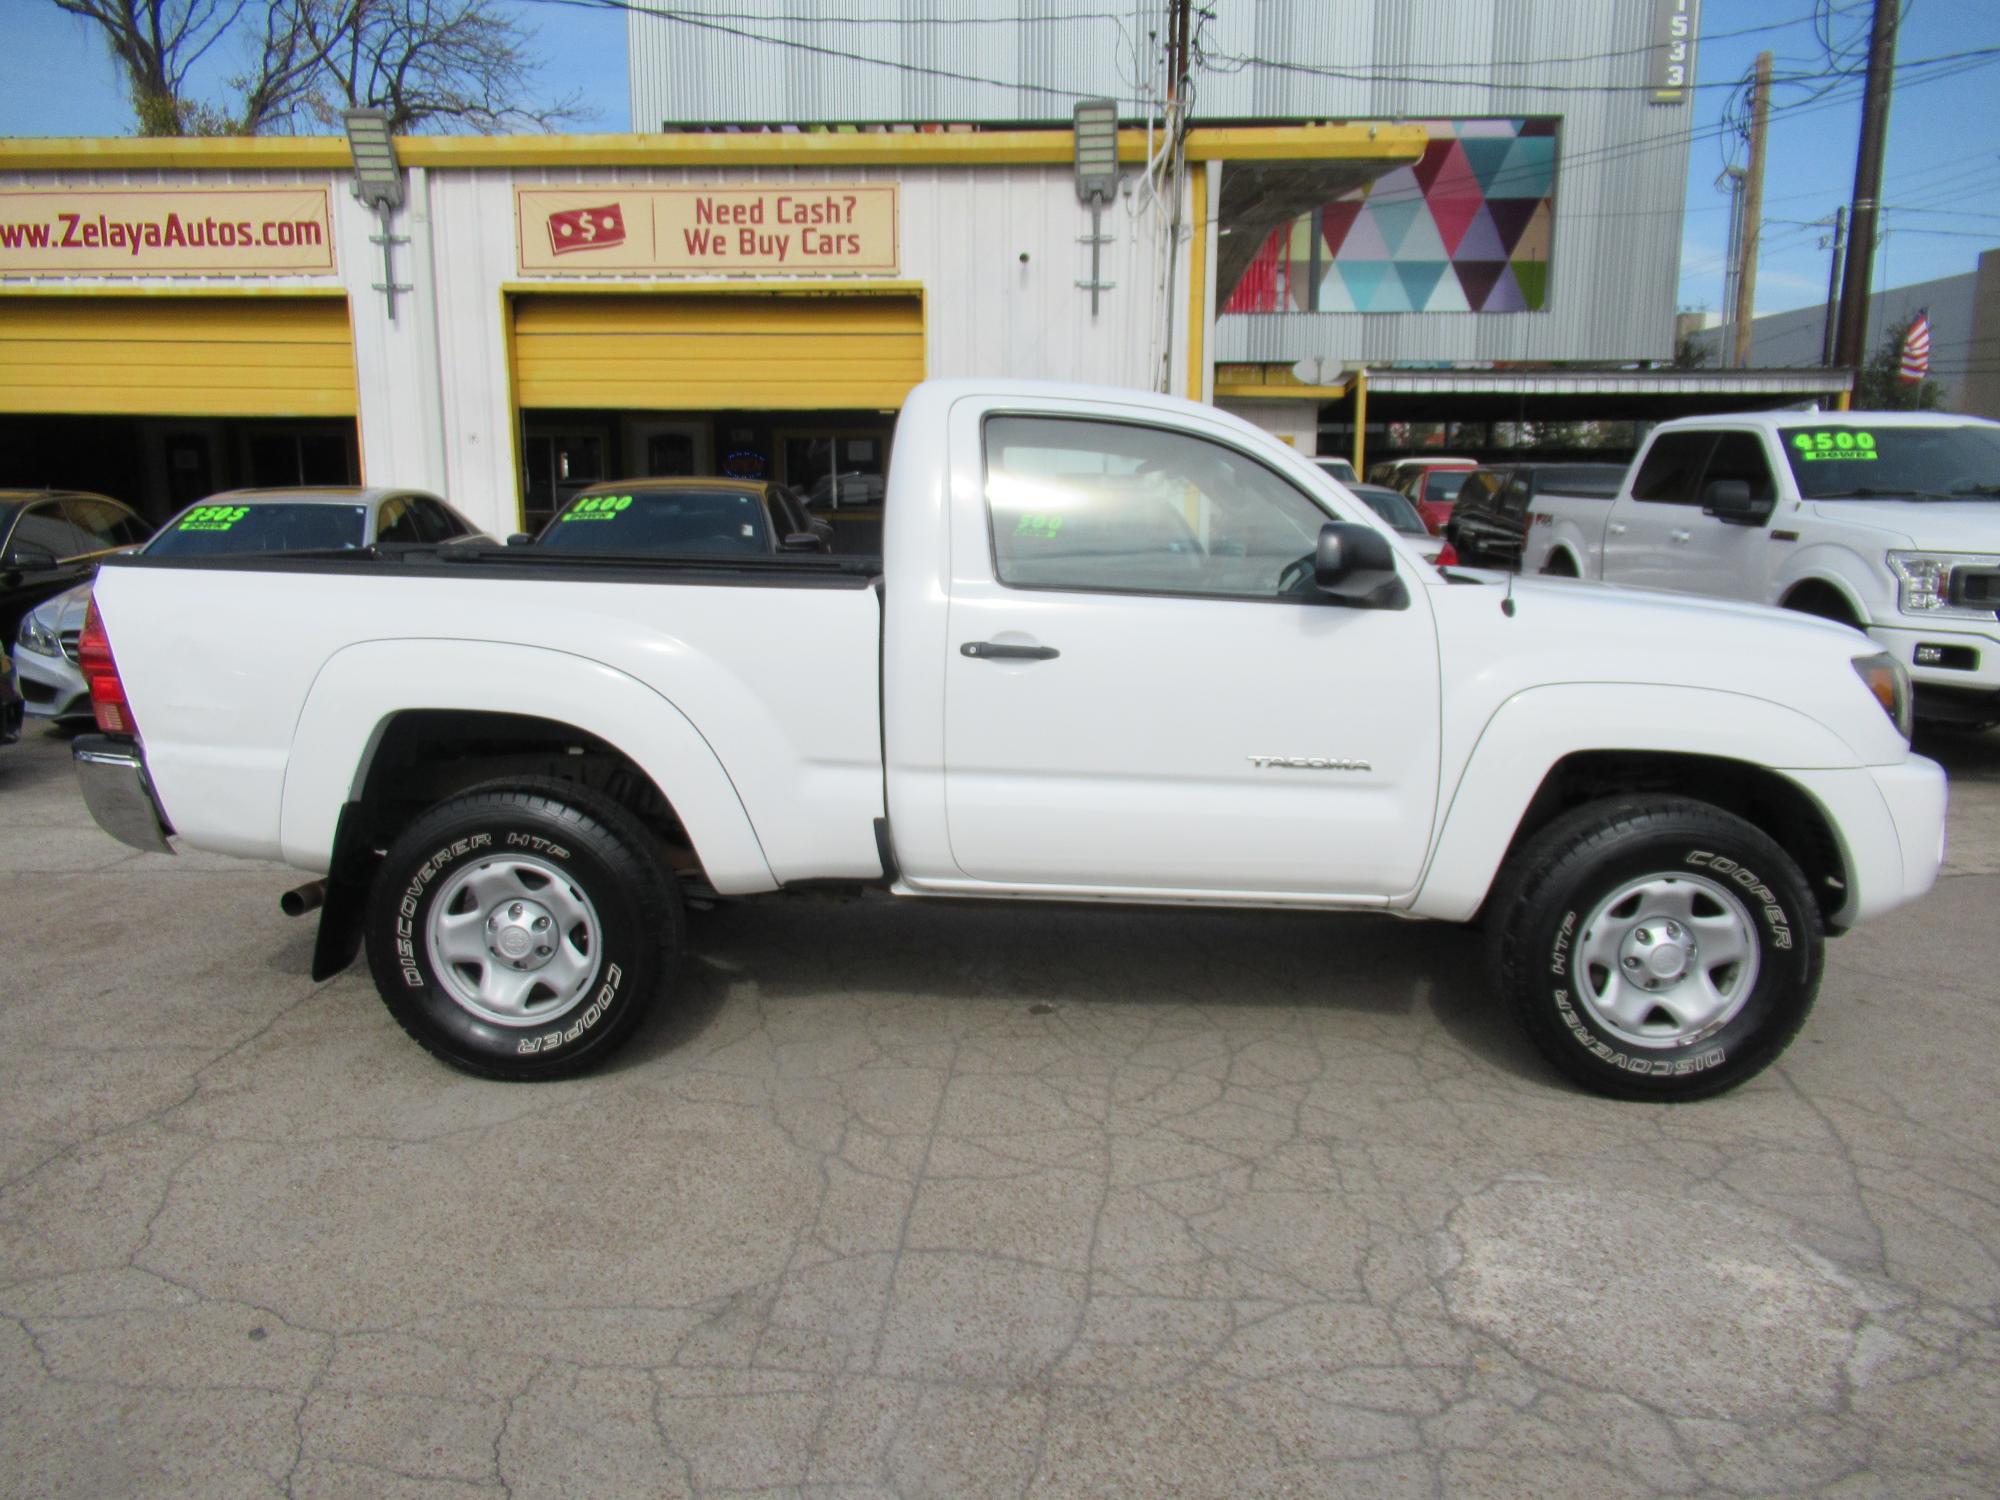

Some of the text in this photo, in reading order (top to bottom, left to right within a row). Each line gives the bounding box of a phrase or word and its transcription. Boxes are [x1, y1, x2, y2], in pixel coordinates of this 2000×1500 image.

[695, 196, 857, 224] Need Cash?
[684, 227, 861, 262] We Buy Cars
[573, 495, 633, 513] 1600
[1247, 755, 1372, 771] TACOMA
[396, 832, 571, 987] DISCOVERER HTP
[1686, 850, 1792, 950] COOPER
[518, 962, 622, 1053] COOPER
[1553, 911, 1726, 1075] DISCOVERER HTP
